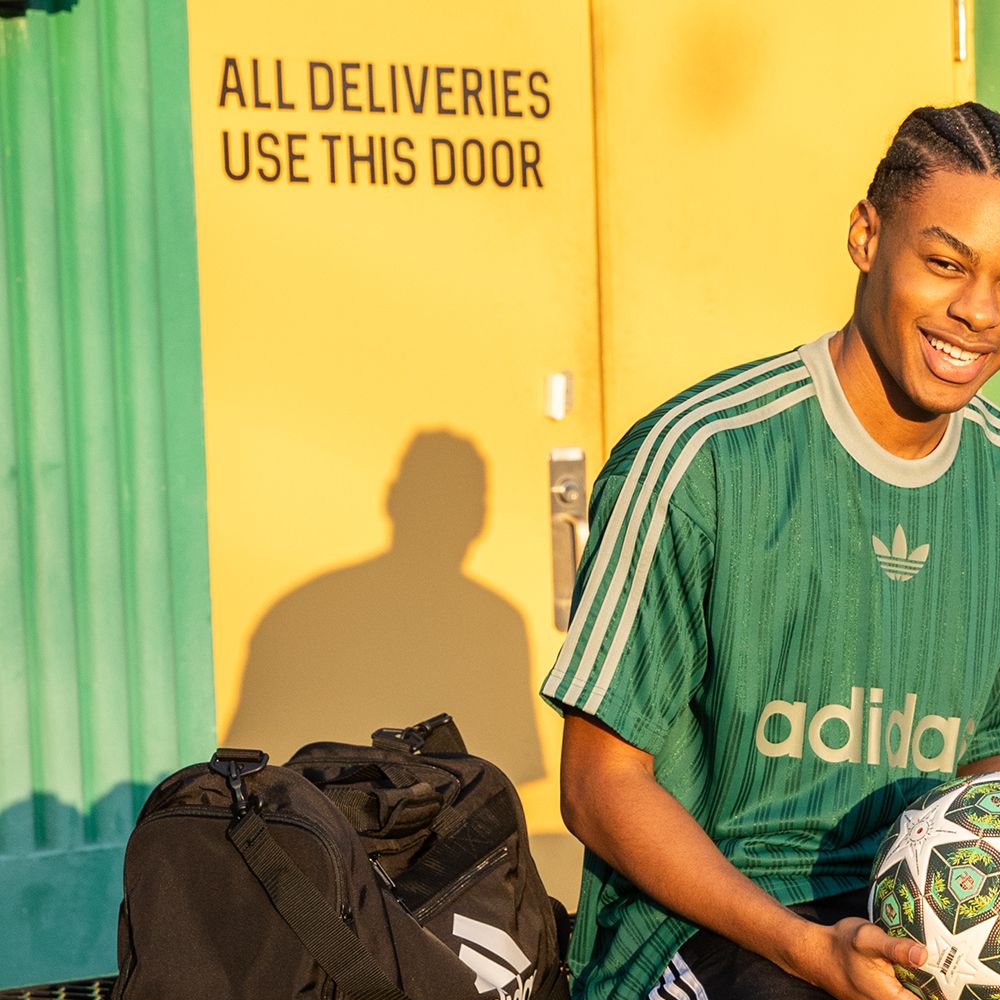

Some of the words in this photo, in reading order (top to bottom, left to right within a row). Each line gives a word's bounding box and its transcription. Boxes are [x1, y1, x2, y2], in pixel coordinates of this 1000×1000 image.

[219, 58, 295, 110] ALL
[308, 61, 551, 119] DELIVERIES
[223, 131, 309, 183] USE
[321, 135, 416, 186] THIS
[432, 138, 544, 188] DOOR
[756, 686, 975, 773] adida
